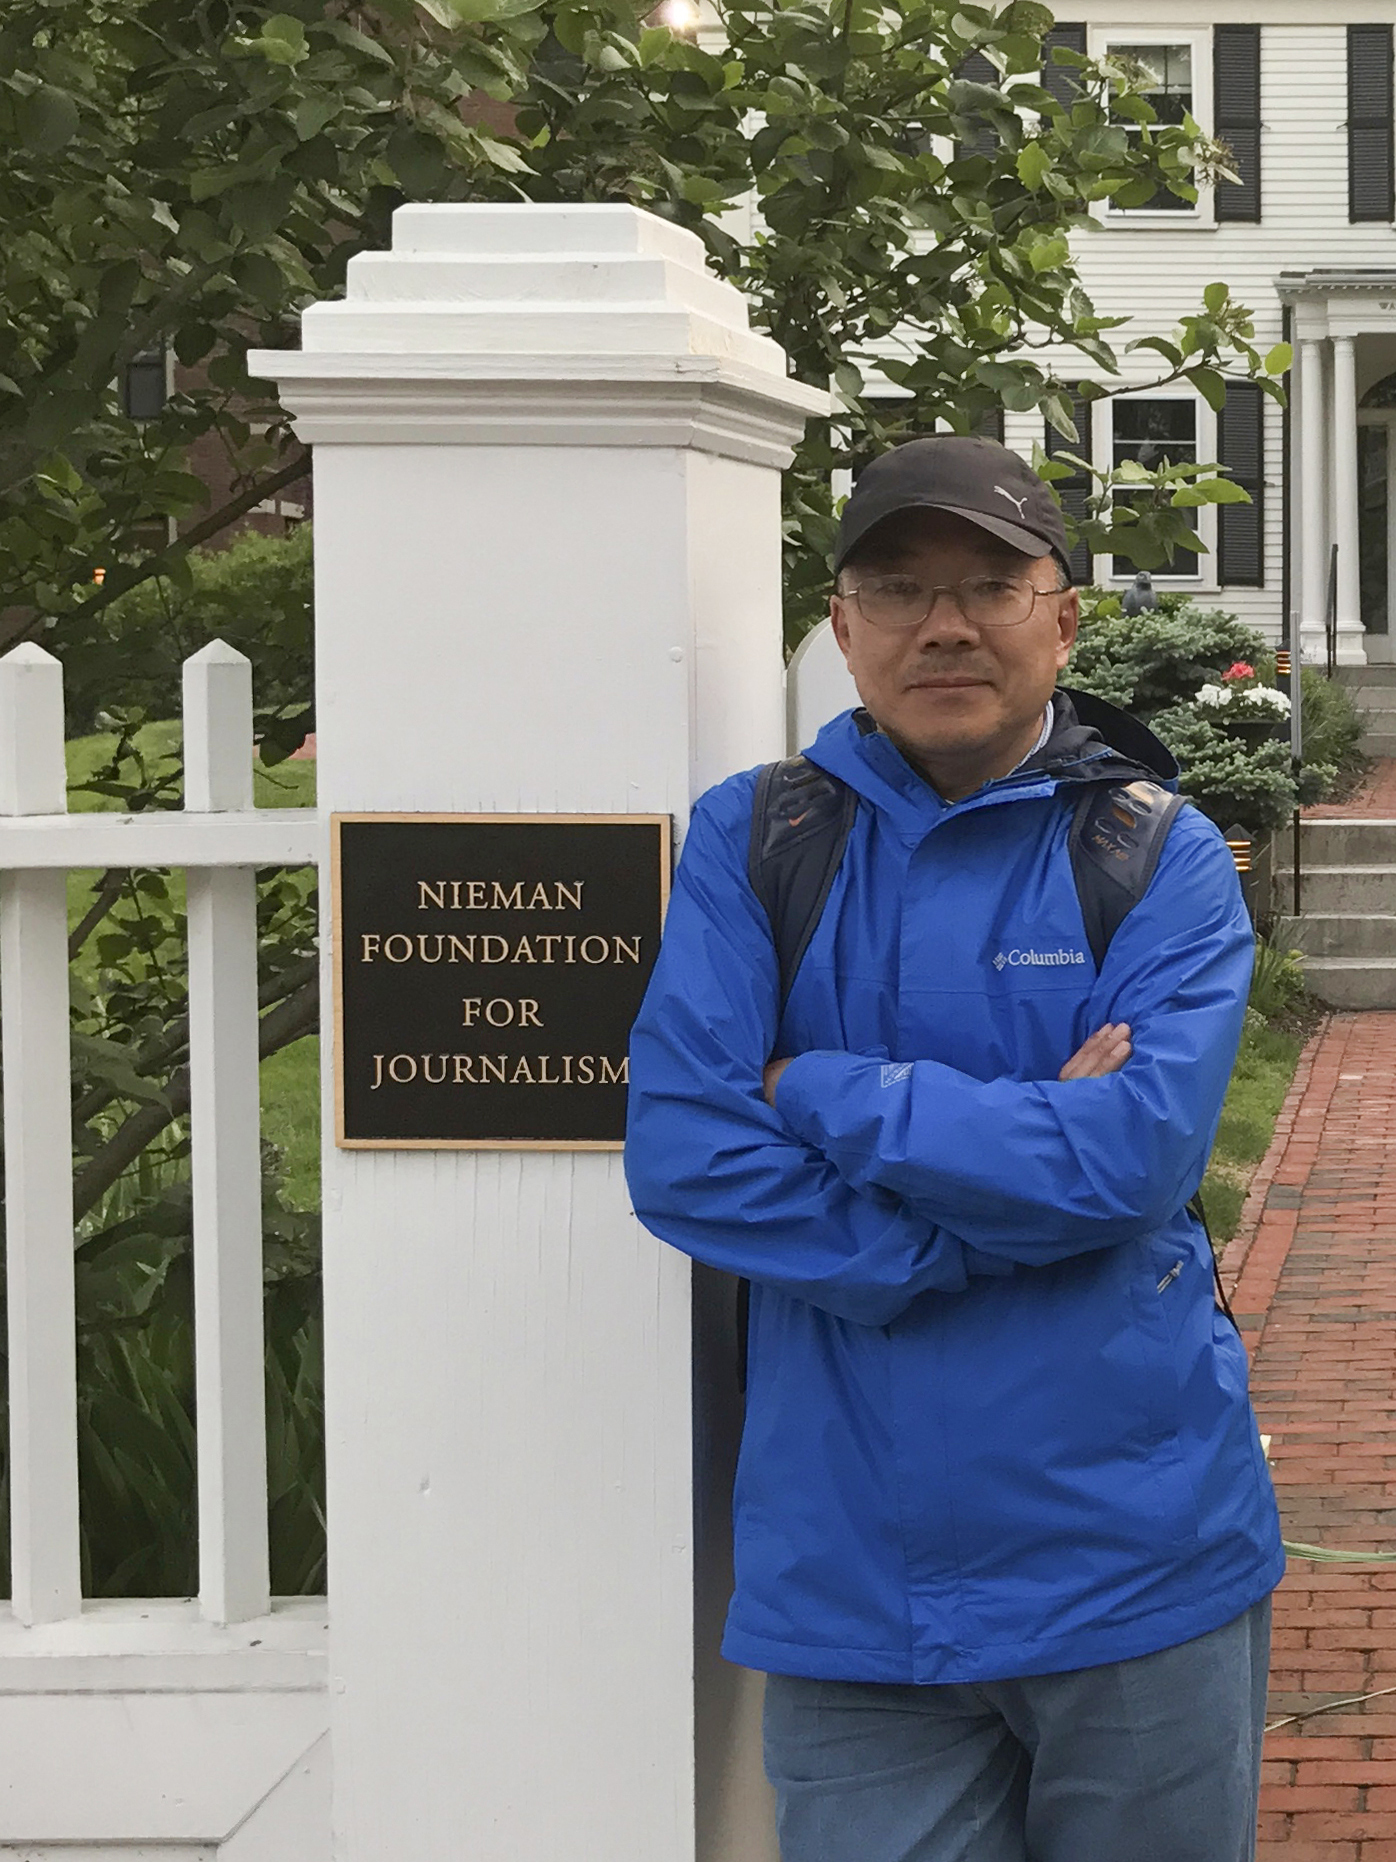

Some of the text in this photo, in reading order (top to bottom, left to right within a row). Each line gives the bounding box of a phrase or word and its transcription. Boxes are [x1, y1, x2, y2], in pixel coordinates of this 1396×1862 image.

[417, 880, 585, 910] NIEMAN
[361, 933, 642, 964] FOUNDATION
[1007, 949, 1086, 966] Columbia
[462, 997, 545, 1027] FOR
[370, 1053, 631, 1090] JOURNALISM
